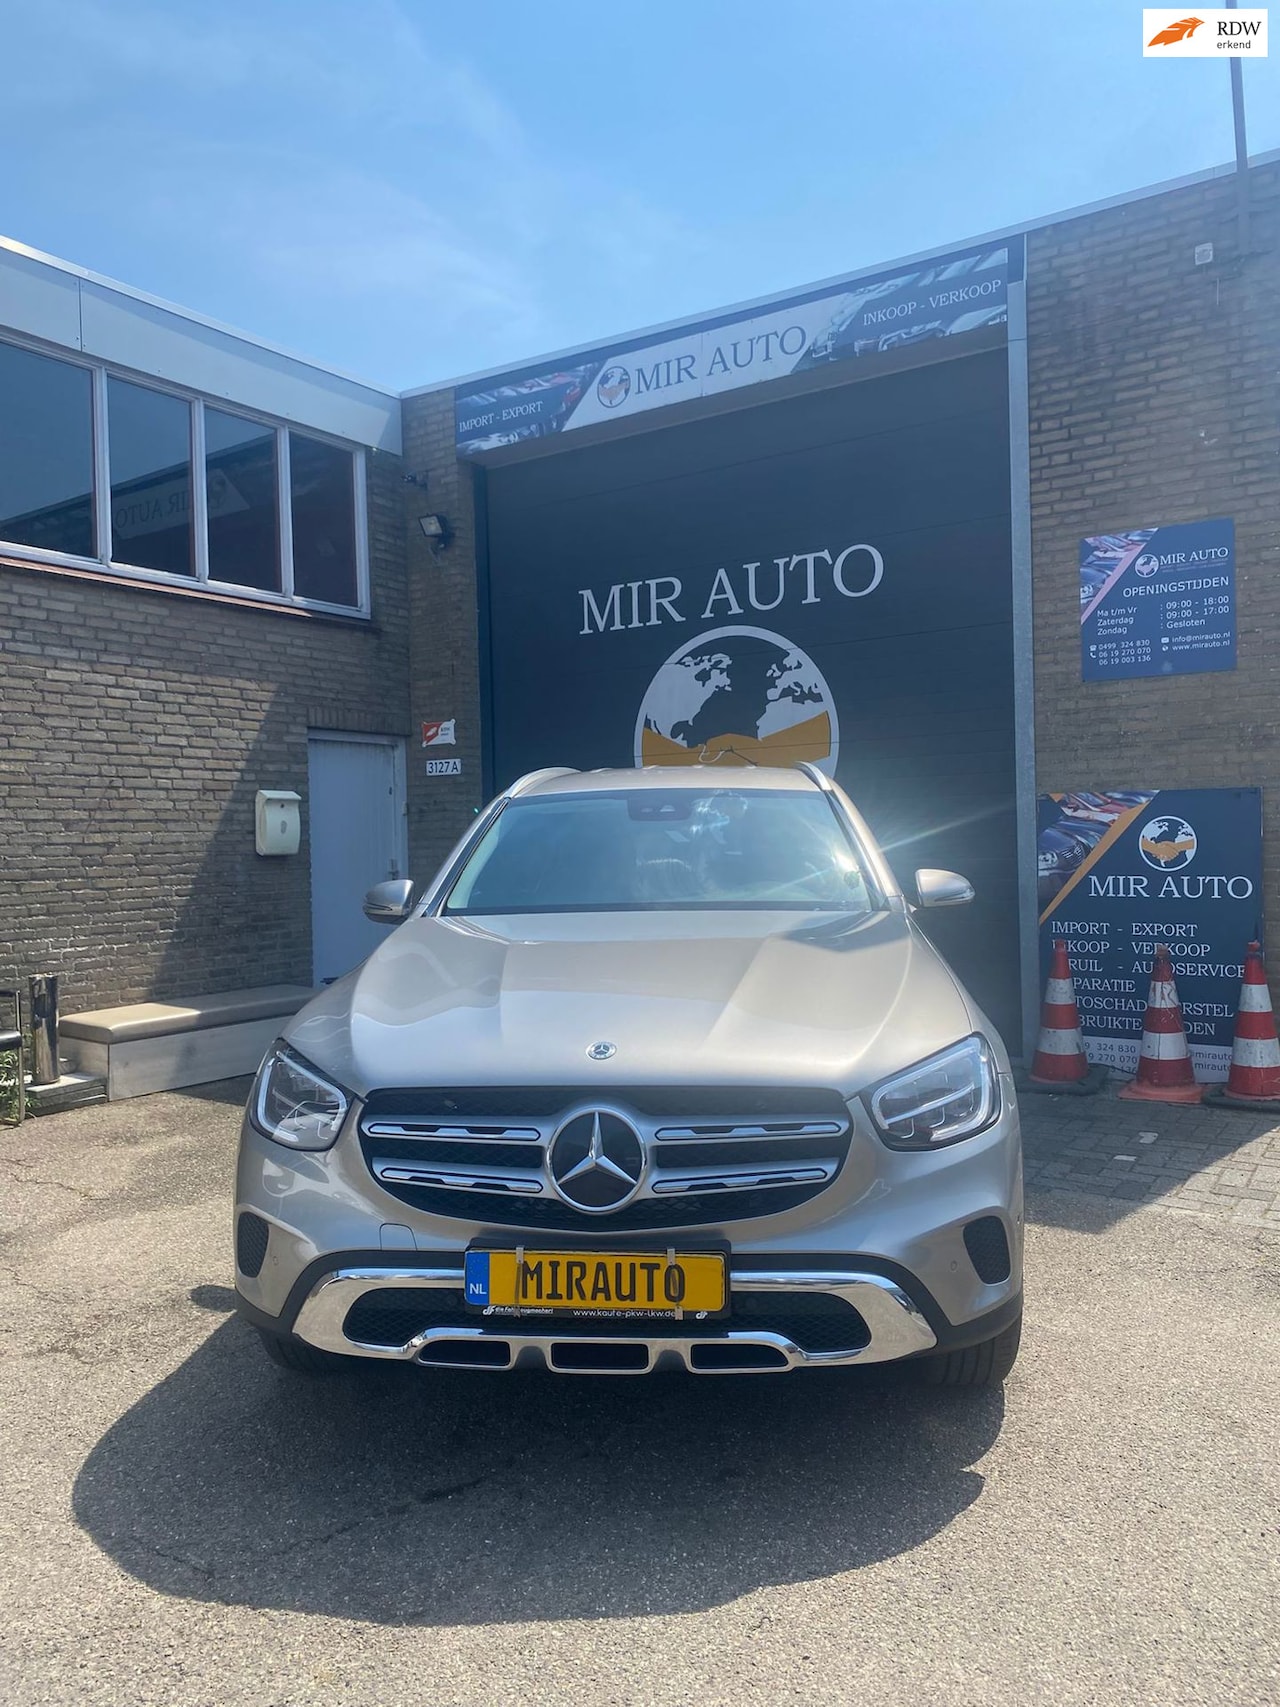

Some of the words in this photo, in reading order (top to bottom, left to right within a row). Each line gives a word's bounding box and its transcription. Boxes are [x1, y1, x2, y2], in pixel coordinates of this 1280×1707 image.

[863, 301, 917, 326] INKOOP
[929, 279, 1002, 309] VERKOOP
[635, 354, 698, 395] MIR
[706, 326, 807, 377] AUTO
[459, 413, 495, 433] IMPORT
[502, 400, 544, 421] EXPORT
[1160, 552, 1186, 566] MIR
[1190, 547, 1229, 562] AUTO
[578, 576, 686, 635] MIR
[701, 544, 884, 619] AUTO
[1123, 576, 1229, 598] OPENINGSTIJDEN
[1111, 608, 1126, 616] t/m
[1166, 600, 1192, 610] 09:00
[1204, 595, 1229, 605] 18:00
[1097, 617, 1134, 626] Zaterdag
[1166, 609, 1192, 619] 09:00
[1204, 605, 1230, 615] 17:00
[1097, 627, 1128, 636] Zondag
[1166, 619, 1206, 629] Gesloten
[1136, 639, 1150, 647] 830
[1172, 631, 1230, 643] info@mirauto.nl
[1172, 640, 1230, 650] www.mirauto.nl
[1121, 648, 1135, 656] 270
[1088, 875, 1150, 898] MIR
[1158, 876, 1254, 899] AUTO
[1052, 921, 1110, 935] IMPORT
[1131, 923, 1198, 937] EXPORT
[1052, 940, 1110, 954] IKOOP
[1131, 961, 1246, 978] AUSERVICE
[1073, 978, 1136, 993] PARATIE
[1096, 1042, 1114, 1051] 324
[1118, 1044, 1136, 1053] 830
[1098, 1053, 1115, 1062] 270
[1120, 1055, 1137, 1064] 070
[469, 1283, 487, 1295] NL
[521, 1260, 685, 1303] MIRAUTO
